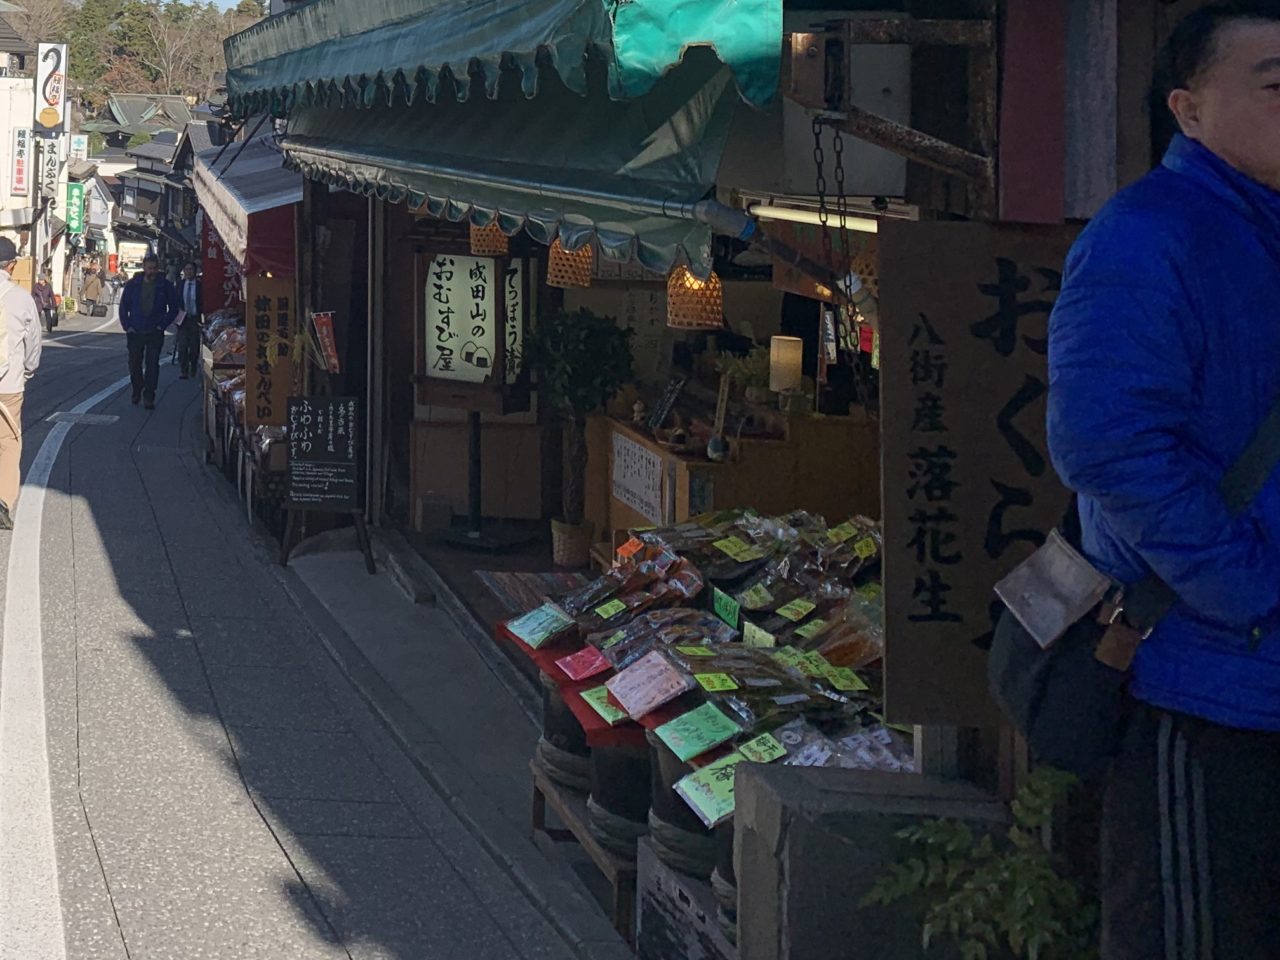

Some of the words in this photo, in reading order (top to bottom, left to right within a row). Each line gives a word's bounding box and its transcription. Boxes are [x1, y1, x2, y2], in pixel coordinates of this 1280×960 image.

[432, 257, 459, 373] おむすび屋
[469, 261, 488, 338] 成田山の
[299, 400, 313, 453] ふわふわ
[906, 312, 964, 624] 八街産落花生
